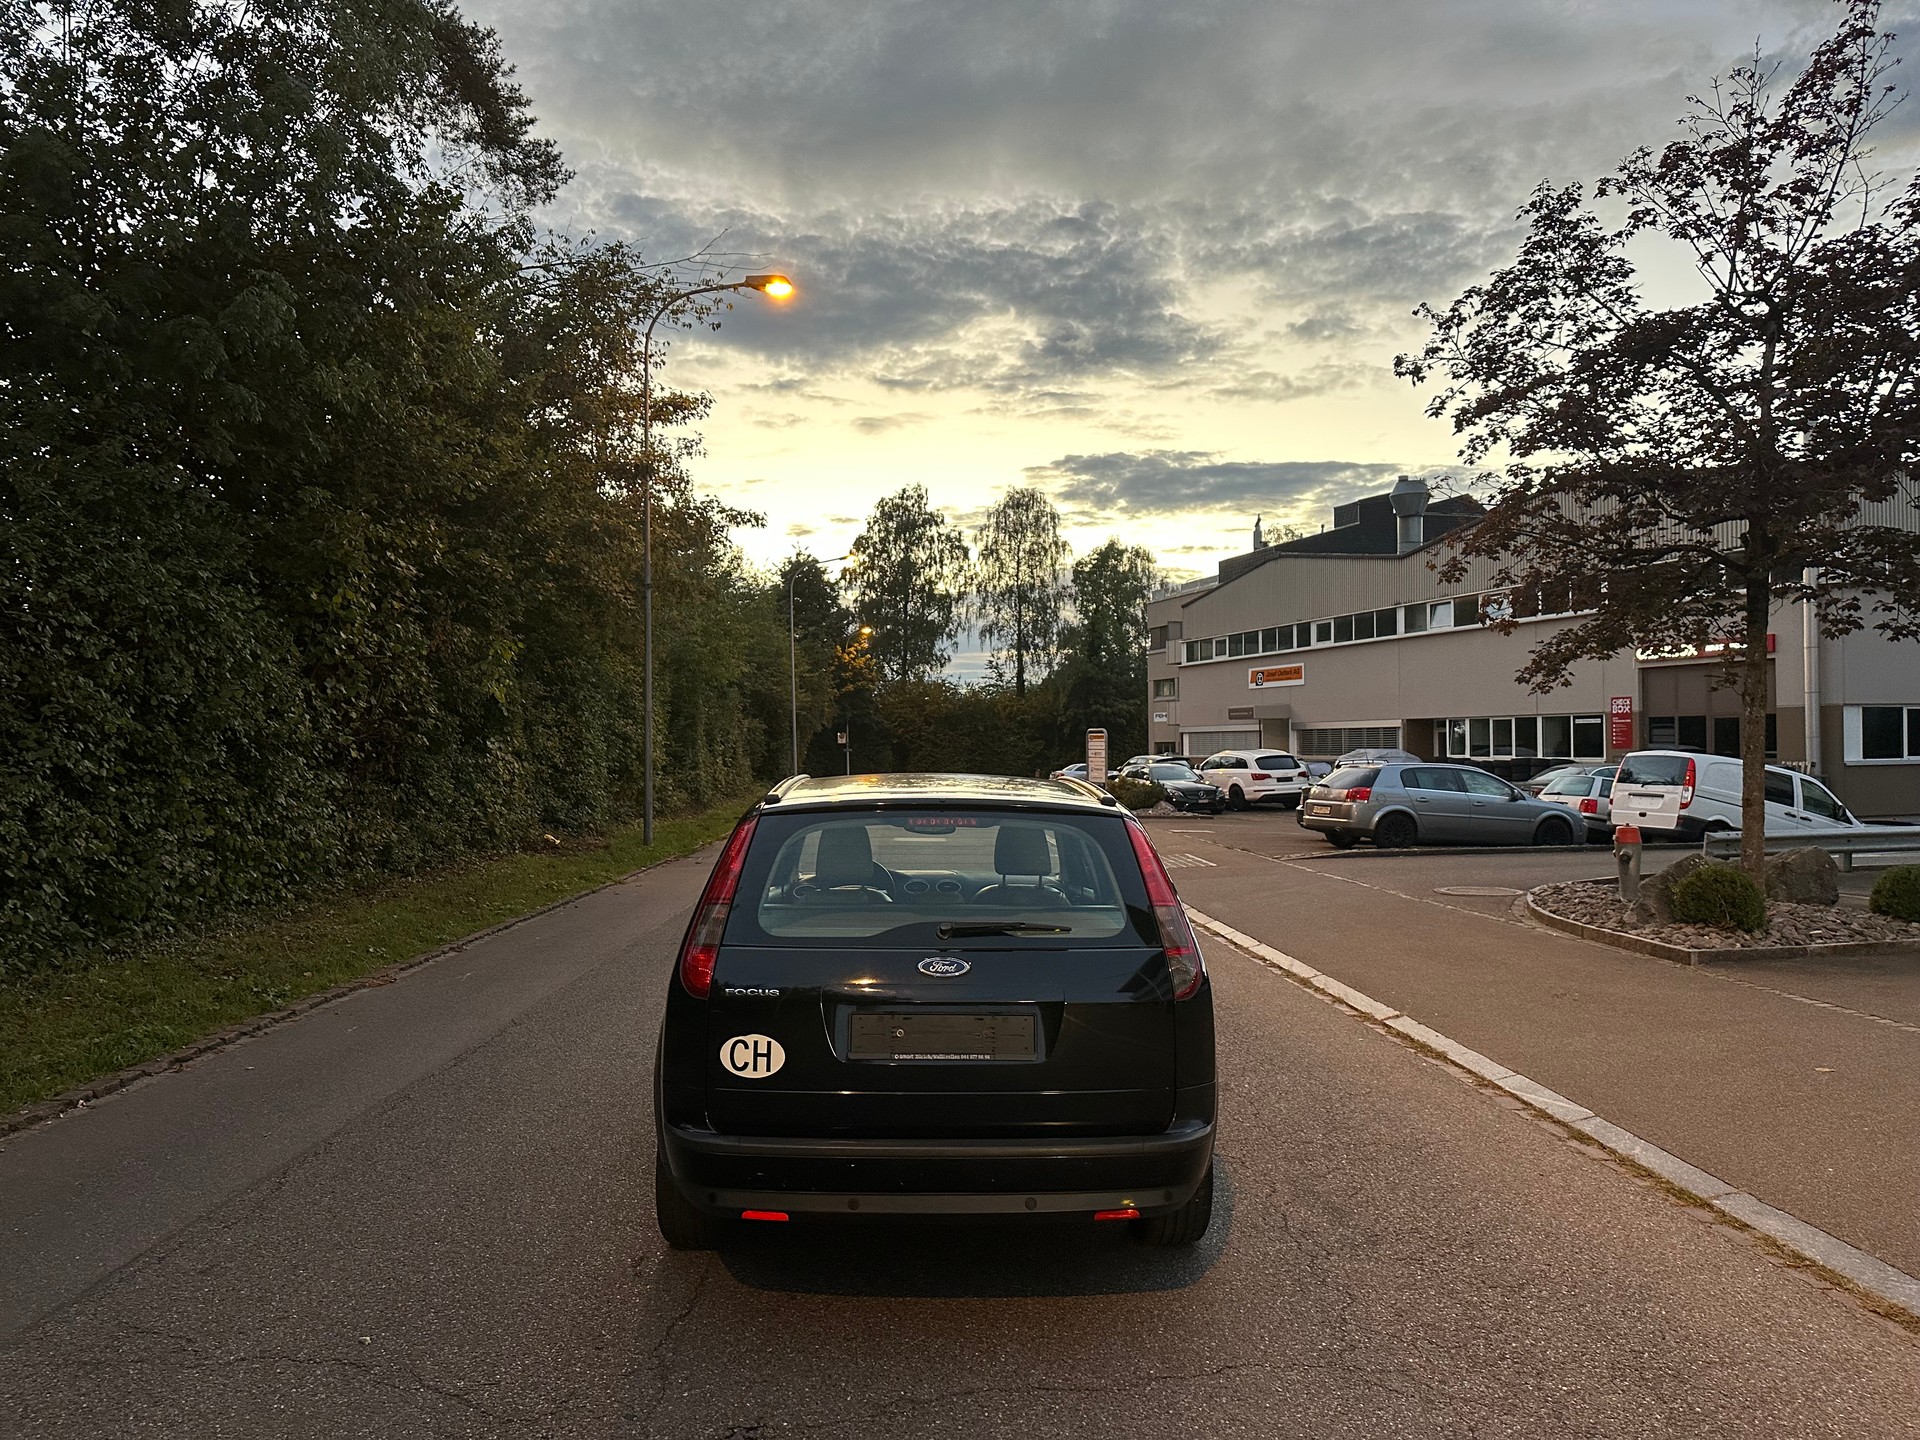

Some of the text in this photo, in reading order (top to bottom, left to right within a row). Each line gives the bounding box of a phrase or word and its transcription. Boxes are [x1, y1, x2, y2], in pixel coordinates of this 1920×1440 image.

[1612, 705, 1631, 714] BOX
[929, 960, 957, 973] Ford
[725, 988, 780, 997] FOCUS
[729, 1039, 772, 1073] CH
